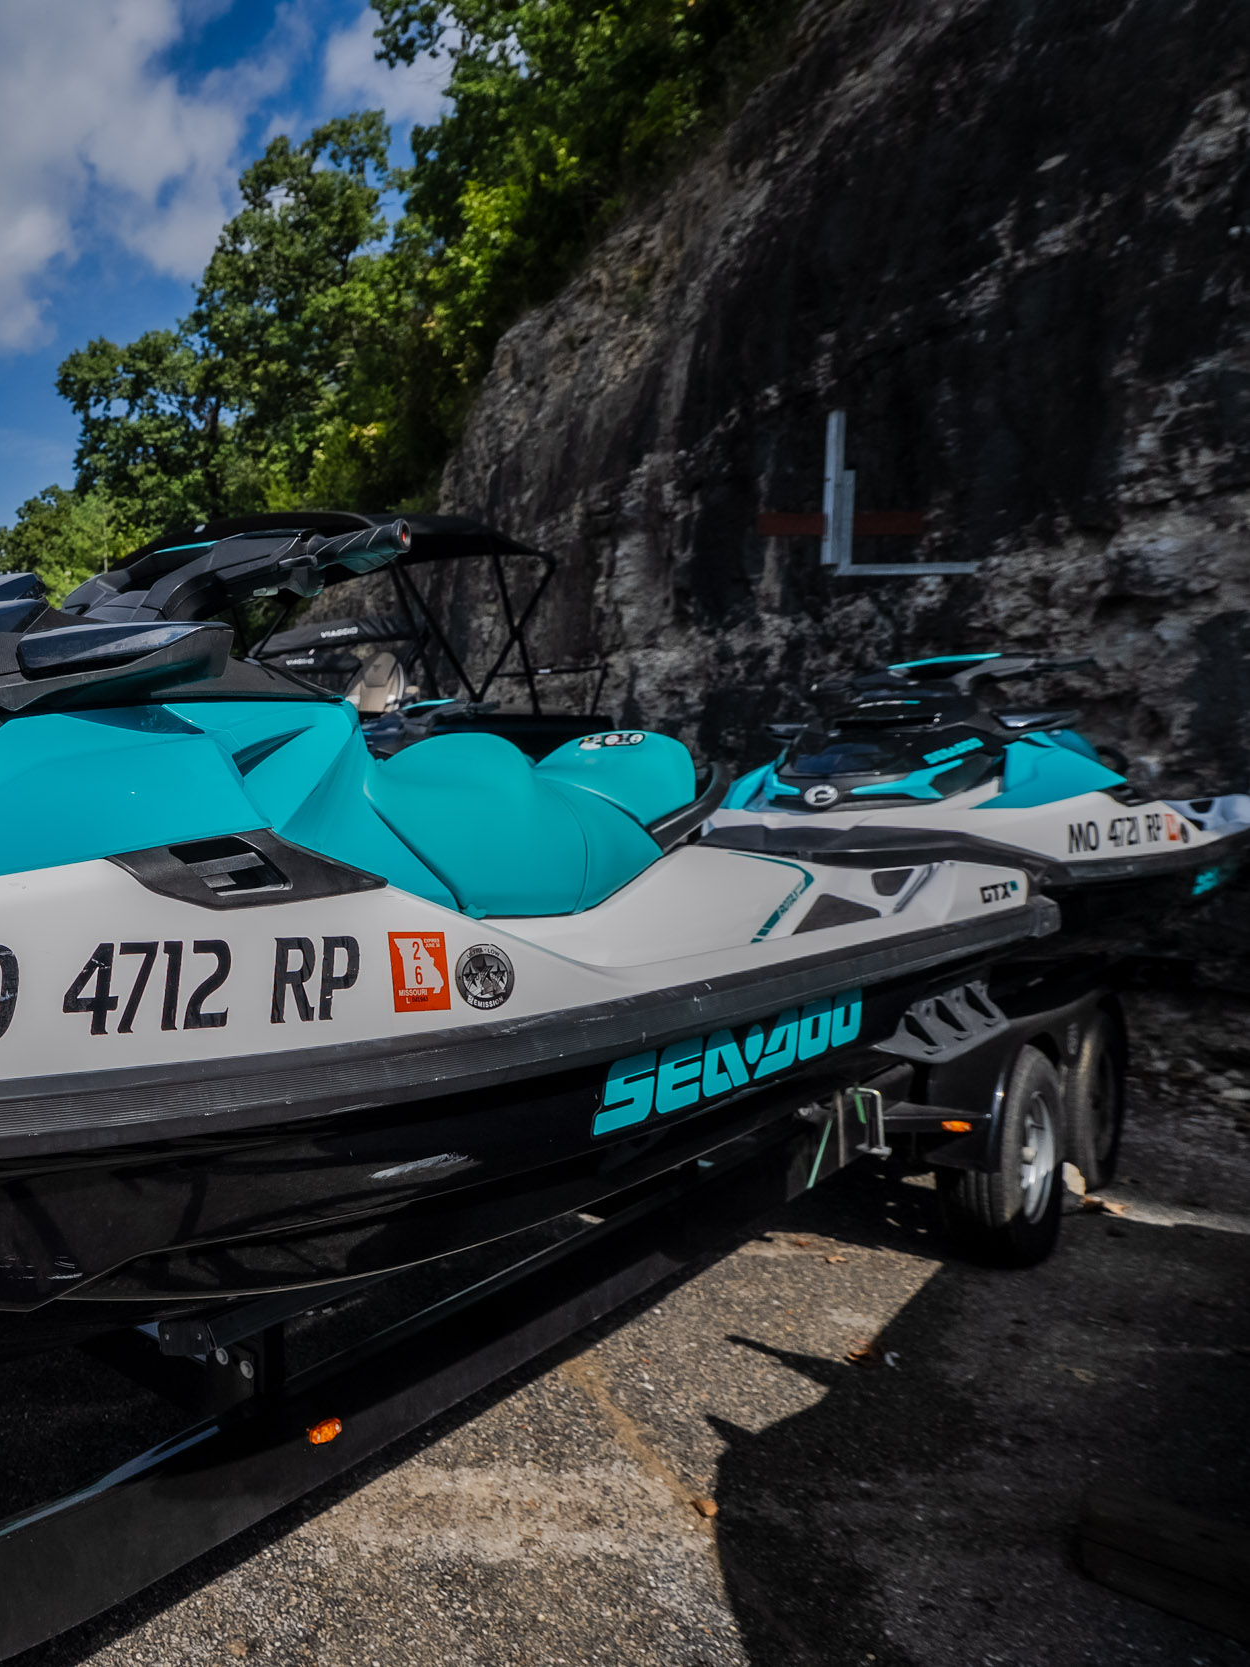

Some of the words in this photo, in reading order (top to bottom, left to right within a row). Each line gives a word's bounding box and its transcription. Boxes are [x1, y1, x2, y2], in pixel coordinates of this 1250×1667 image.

[1068, 820, 1100, 854] MO
[1145, 813, 1162, 842] RP
[979, 881, 1012, 904] GTX
[412, 941, 421, 960] 2
[62, 939, 232, 1035] 4712
[270, 936, 360, 1025] RP
[415, 965, 423, 985] 6
[398, 988, 428, 997] MISSOURI
